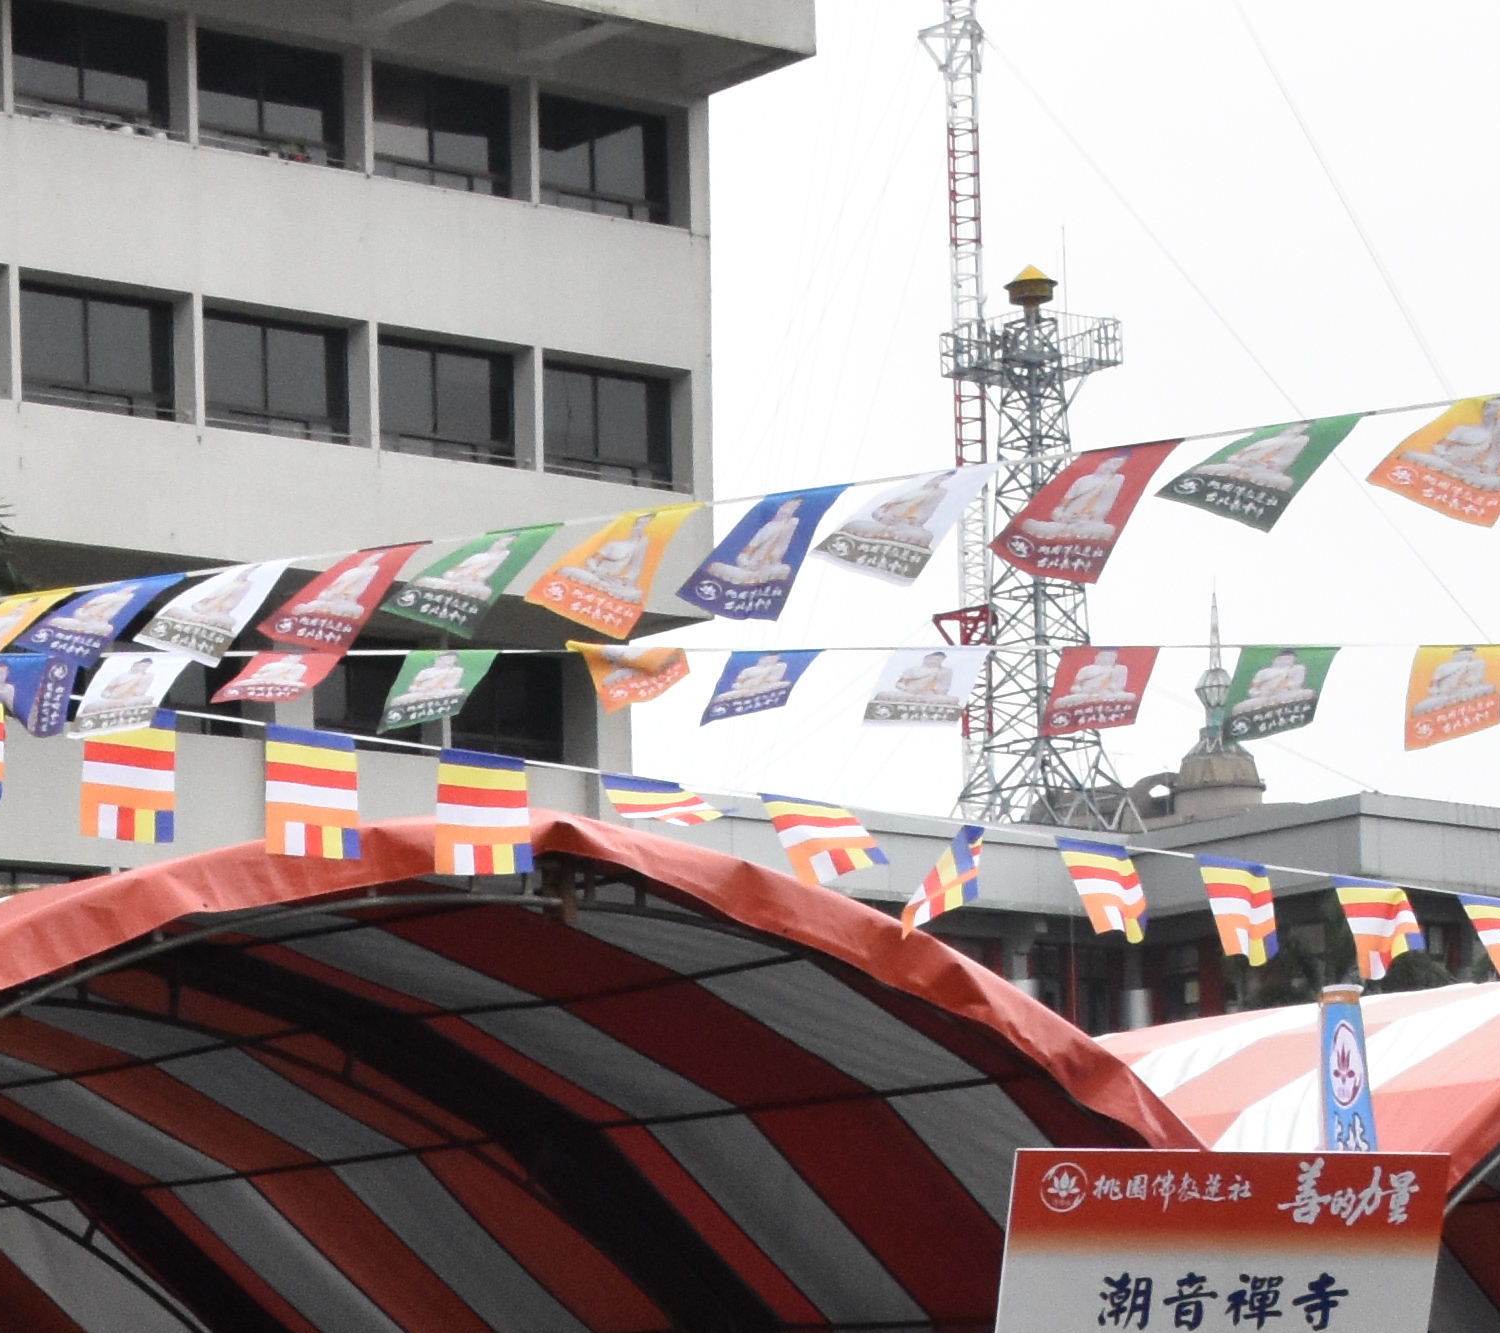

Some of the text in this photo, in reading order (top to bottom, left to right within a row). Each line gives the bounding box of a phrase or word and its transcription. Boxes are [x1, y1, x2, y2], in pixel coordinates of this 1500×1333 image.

[1093, 1170, 1252, 1212] 桃園佛教蓮社
[1277, 1158, 1419, 1226] 善的力量
[1097, 1271, 1349, 1331] 潮音禪寺
